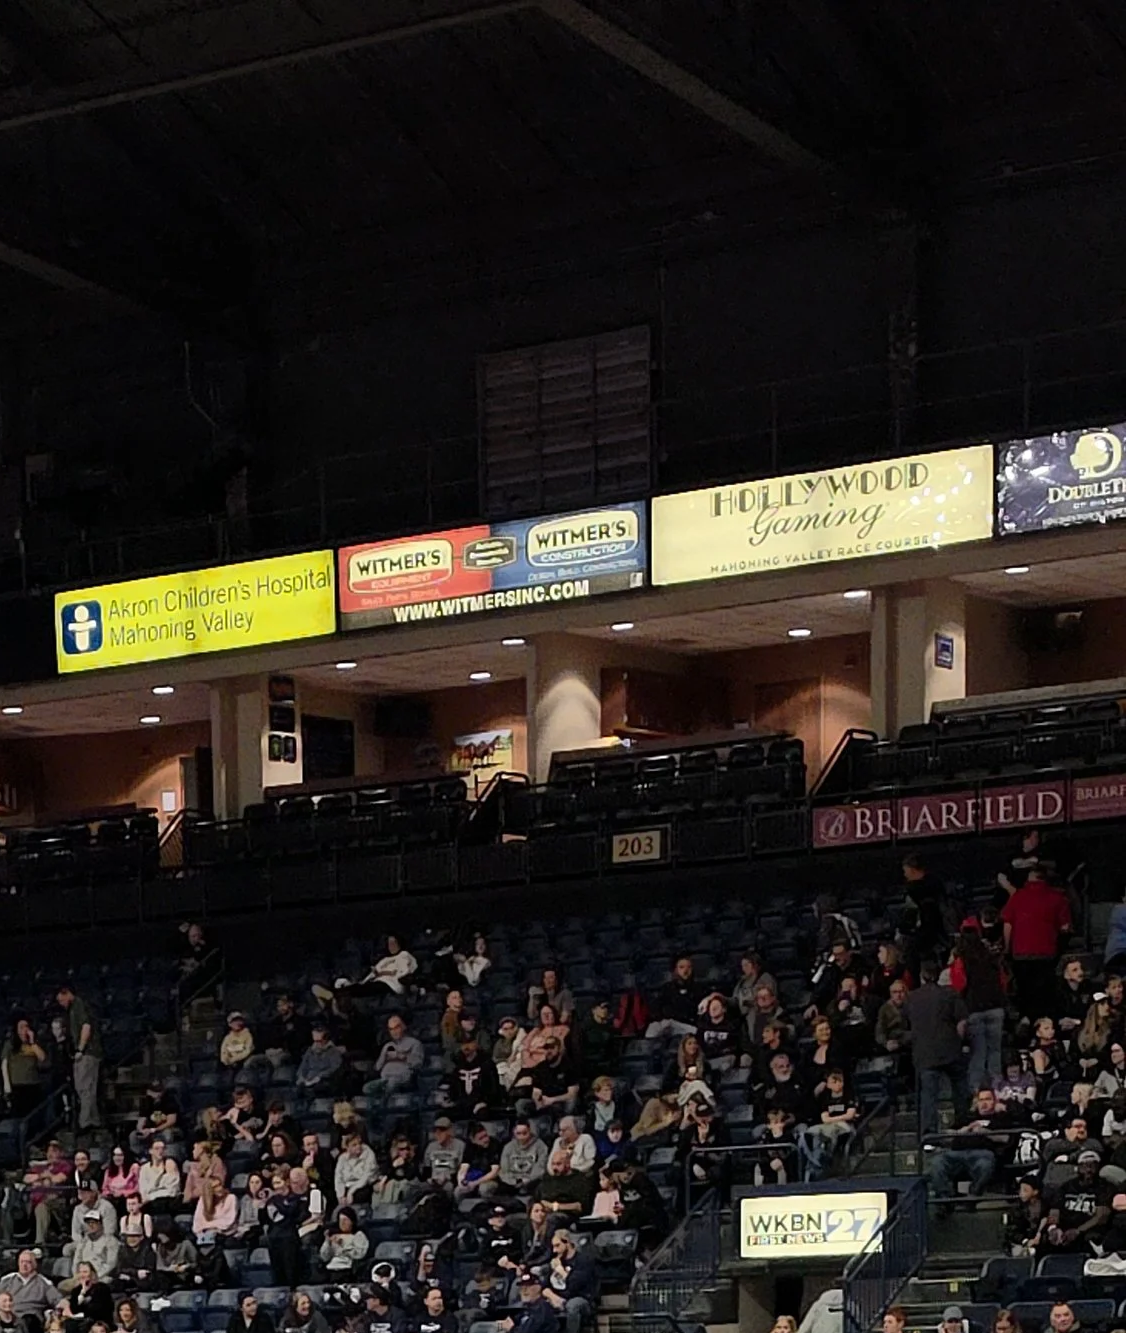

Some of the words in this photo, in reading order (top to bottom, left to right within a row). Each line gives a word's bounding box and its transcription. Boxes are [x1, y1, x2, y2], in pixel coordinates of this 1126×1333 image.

[710, 462, 929, 517] HOLLYWOOD
[536, 520, 626, 549] WITMER'S
[748, 502, 886, 547] Gaming
[357, 549, 441, 577] WITMER'S
[540, 543, 626, 563] CONSTRUCTION
[710, 555, 781, 574] MAHONING
[784, 548, 832, 564] VALLEY
[838, 543, 871, 556] RACE
[875, 535, 929, 550] COURSE
[108, 598, 159, 621] Akron
[164, 579, 251, 613] Children's
[256, 565, 331, 598] Hospital
[393, 580, 589, 623] WWW.WITMERSINC.COM
[109, 617, 196, 647] Mahoning
[201, 610, 254, 634] Valley
[855, 791, 1063, 839] BRIARFIELD
[619, 836, 653, 857] 203
[749, 1213, 821, 1233] WKBN
[827, 1209, 881, 1242] 27
